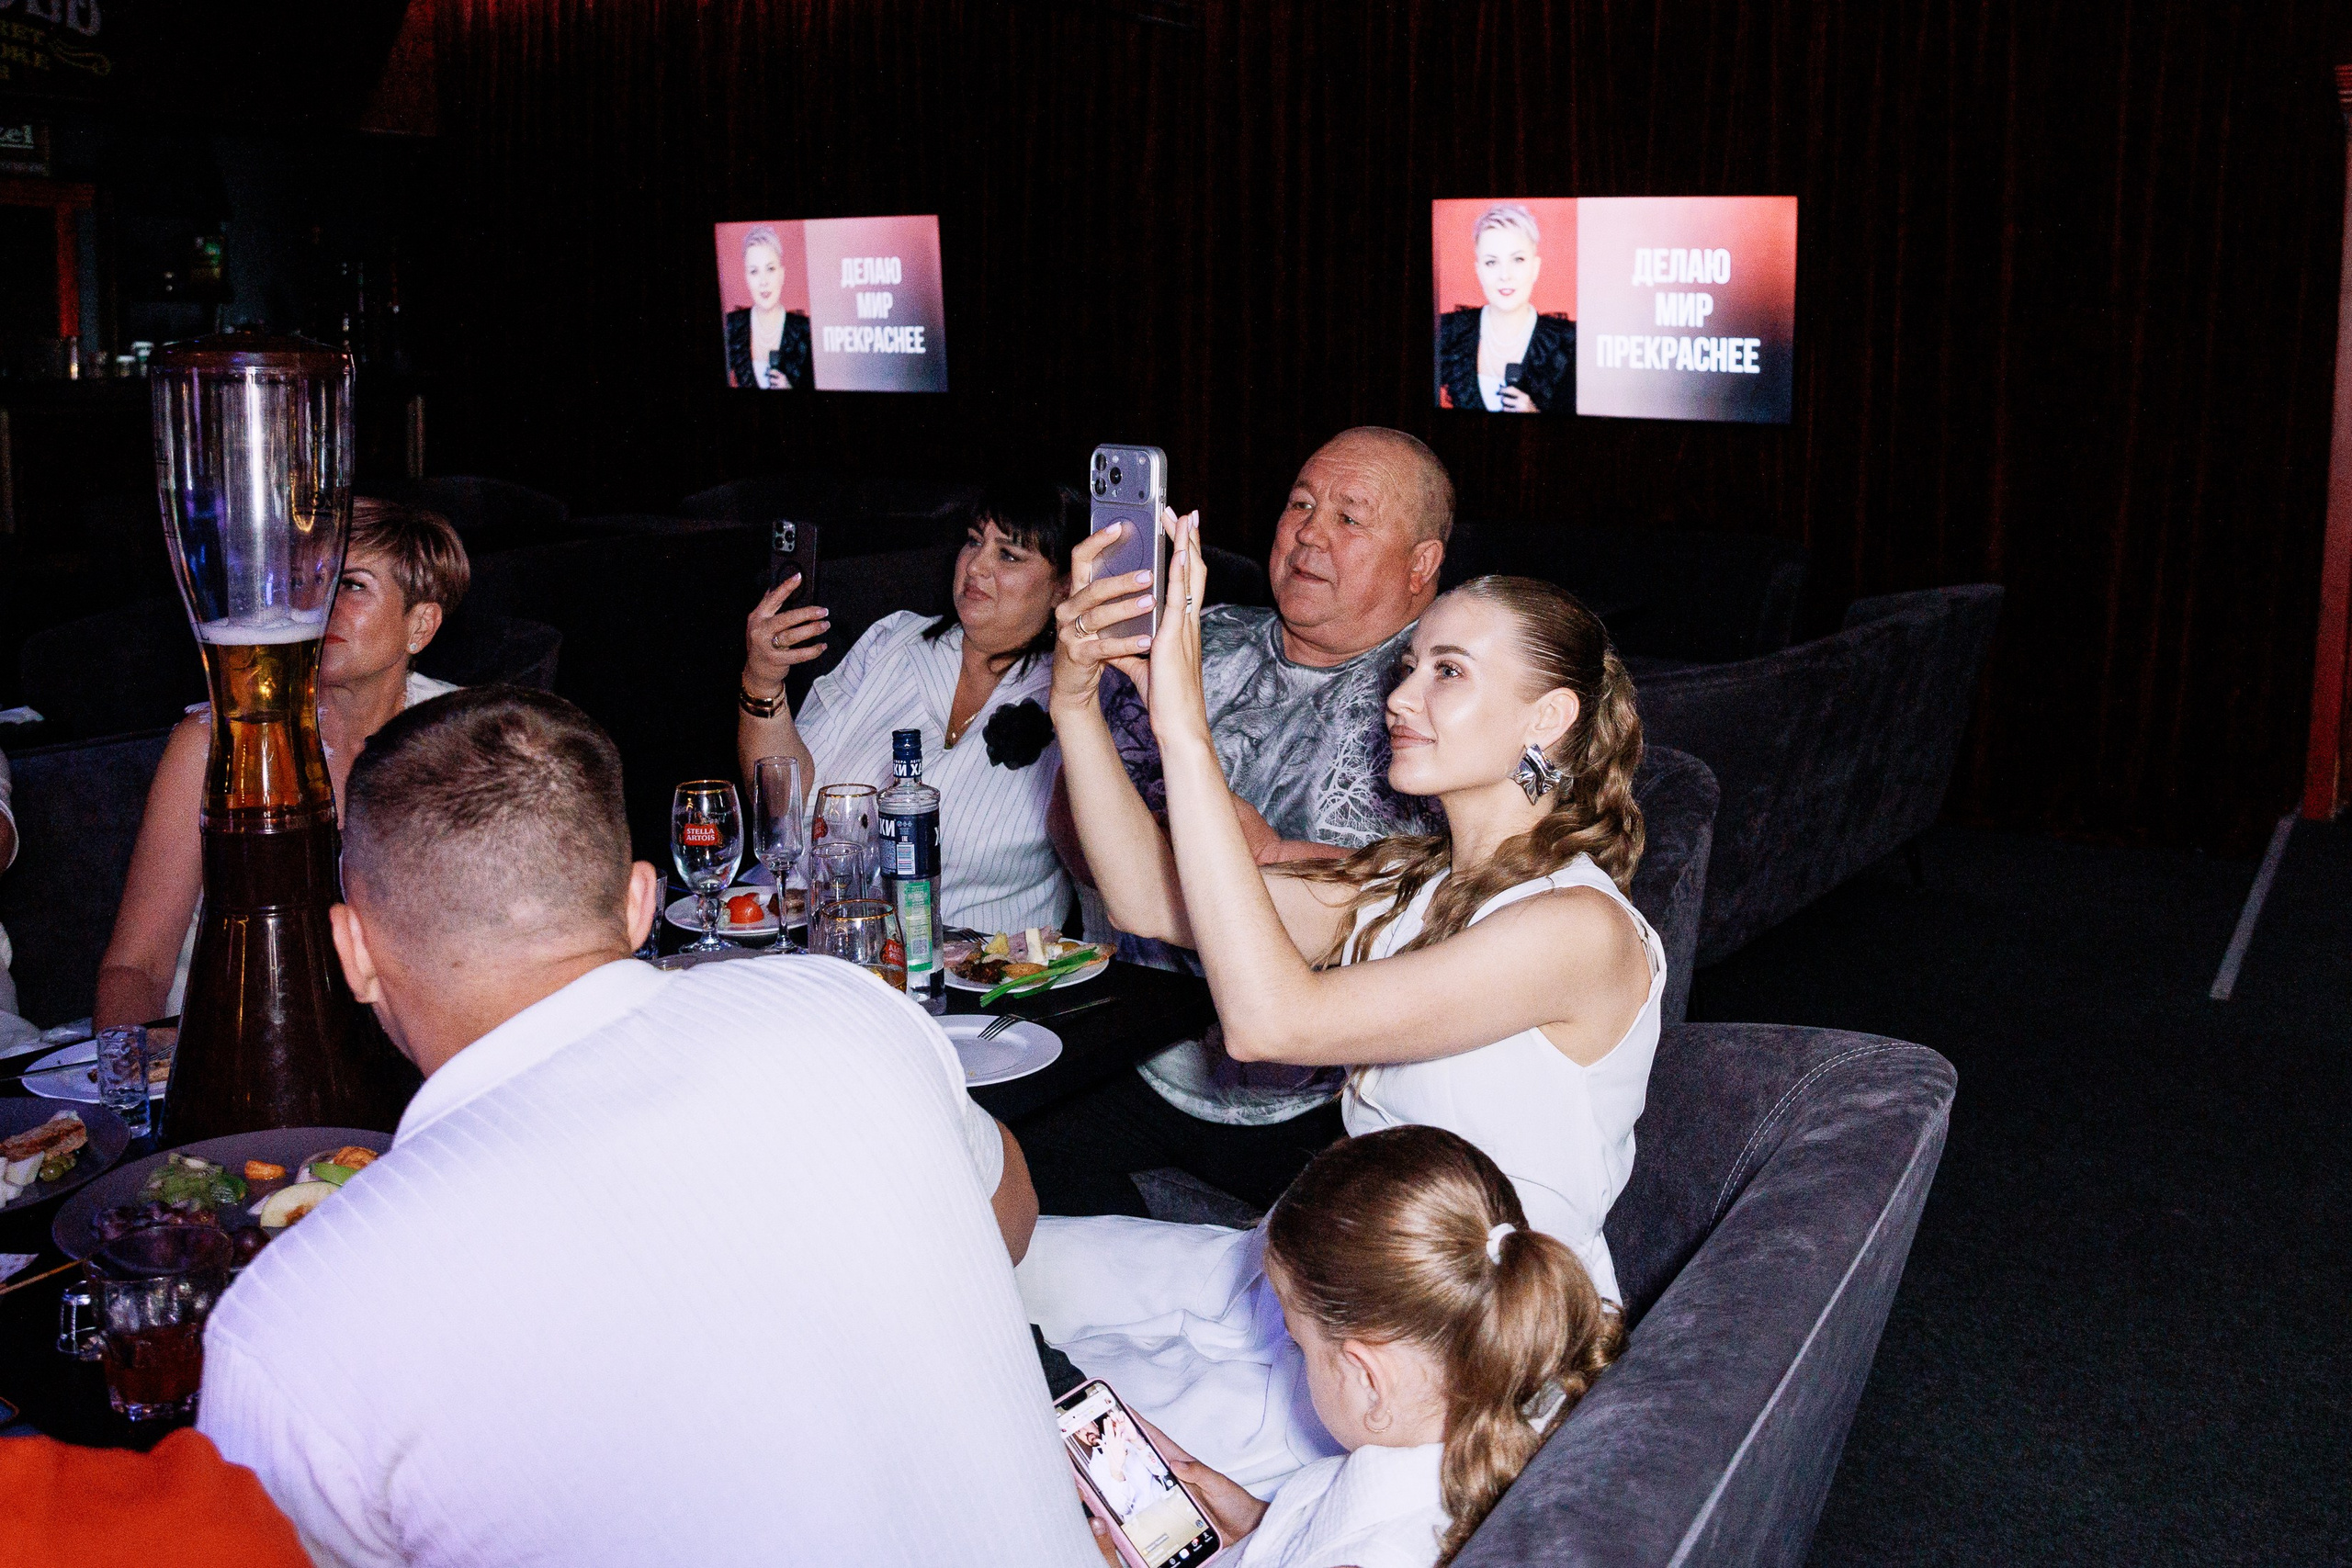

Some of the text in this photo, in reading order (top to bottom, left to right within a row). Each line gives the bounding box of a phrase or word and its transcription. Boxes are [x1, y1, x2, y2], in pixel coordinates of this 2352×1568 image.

[842, 257, 901, 288] ДЕЛАЮ
[1632, 248, 1731, 286] ДЕЛАЮ
[856, 292, 893, 319] МИР
[1656, 292, 1713, 328] МИР
[824, 325, 926, 354] ПРЕКРАСНЕЕ
[1597, 334, 1760, 374] ПРЕКРАСНЕЕ
